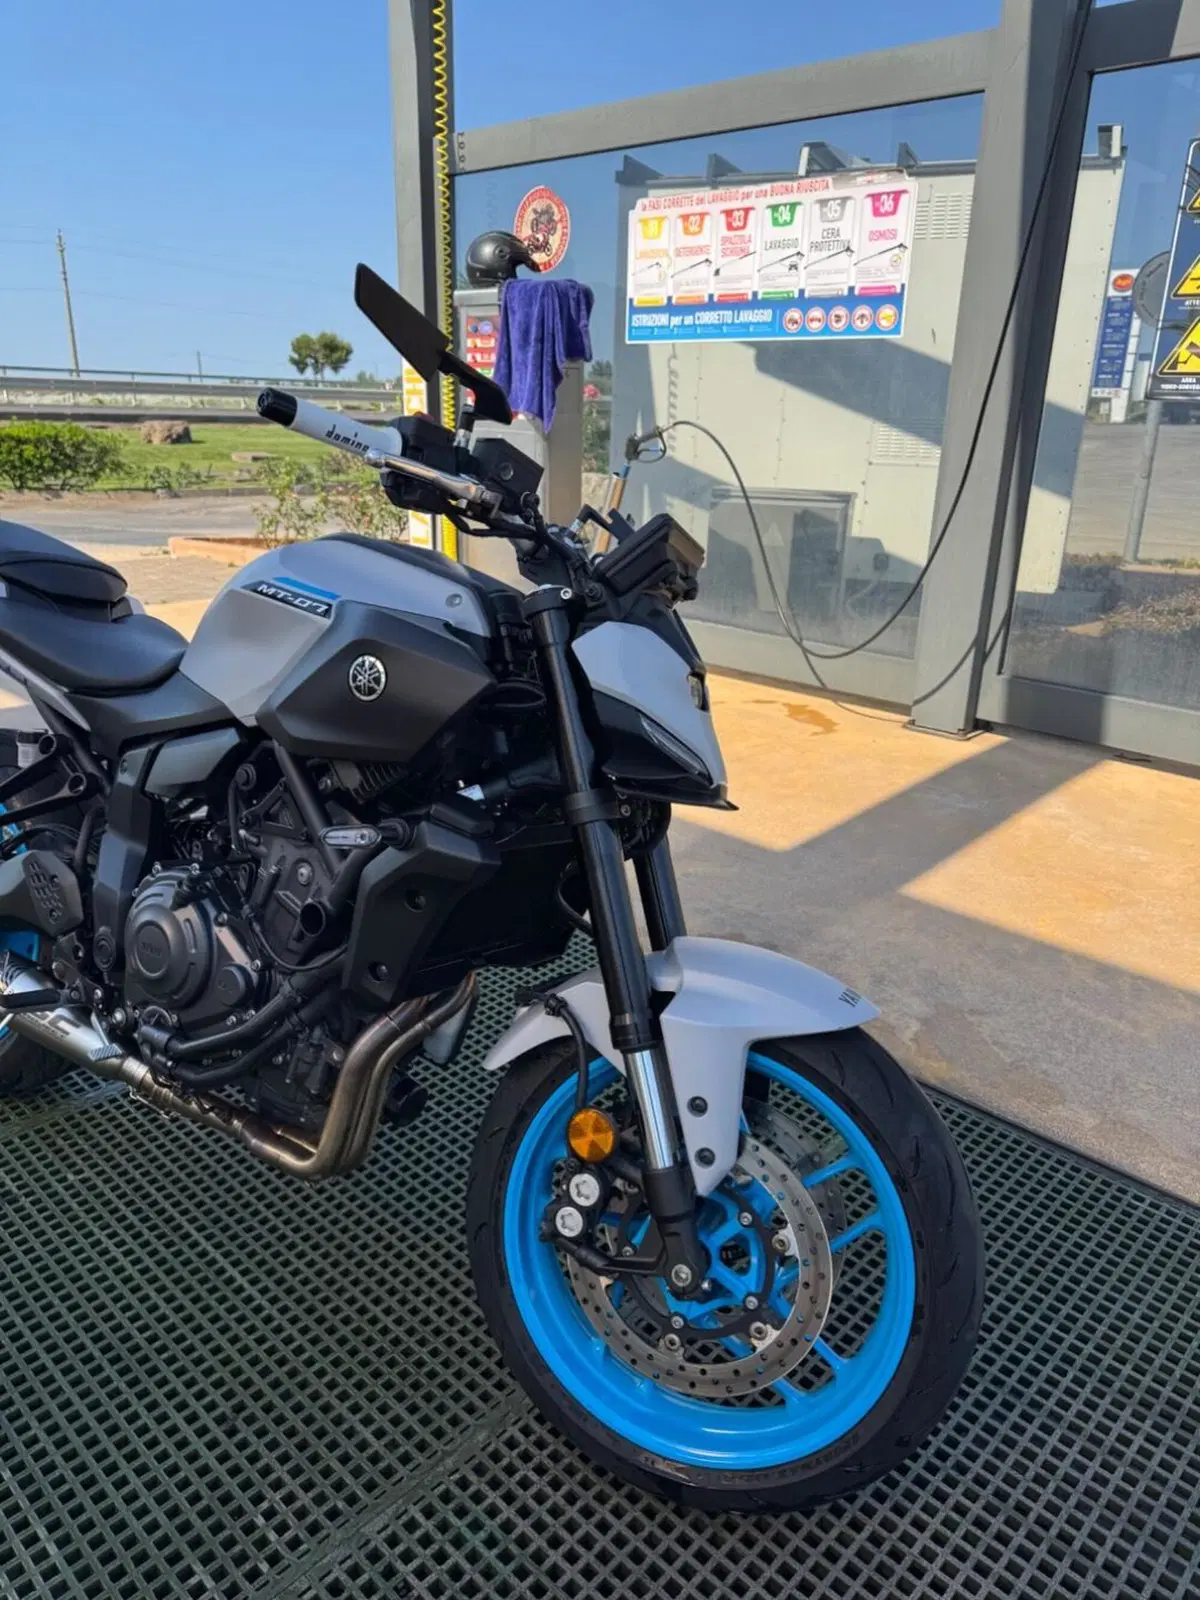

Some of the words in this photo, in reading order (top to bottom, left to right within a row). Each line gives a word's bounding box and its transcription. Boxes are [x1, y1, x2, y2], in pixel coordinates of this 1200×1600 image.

[707, 189, 739, 204] LAVAGGIO
[741, 189, 753, 202] per
[769, 183, 794, 197] BUONA
[796, 179, 830, 195] RIUSCITA
[821, 227, 841, 240] CERA
[868, 228, 898, 242] OSMOSI
[764, 238, 799, 251] LAVAGGIO
[734, 308, 773, 323] LAVAGGIO
[257, 583, 329, 613] MT-07
